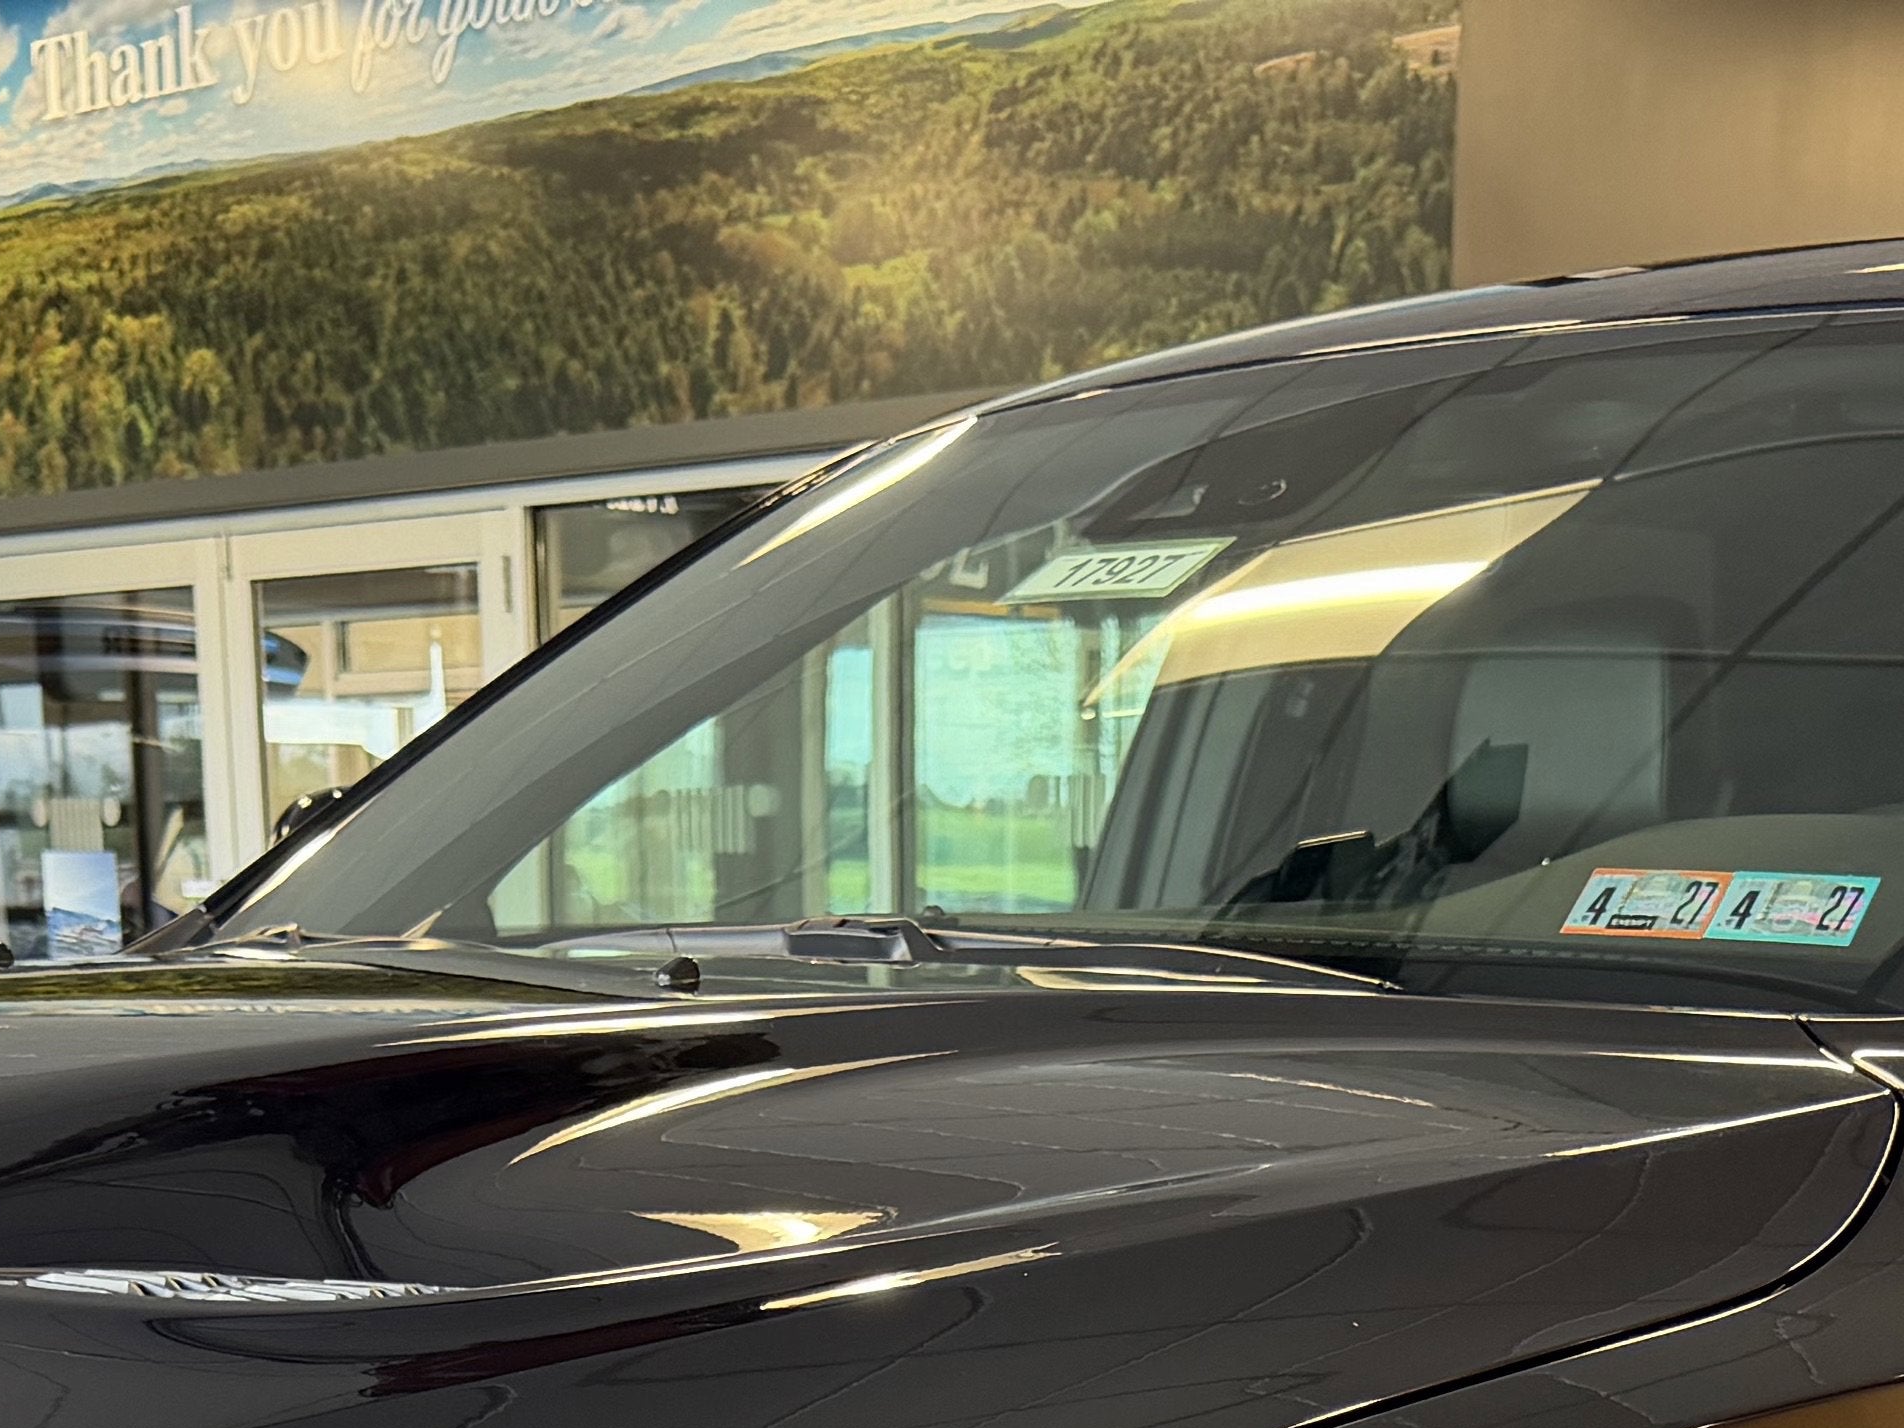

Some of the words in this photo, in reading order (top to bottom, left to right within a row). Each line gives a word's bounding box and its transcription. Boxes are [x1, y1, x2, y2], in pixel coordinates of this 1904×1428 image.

[30, 4, 218, 122] Thank
[230, 0, 344, 104] you
[350, 0, 430, 93] for
[1053, 554, 1185, 588] 17927
[1584, 886, 1616, 925] 4
[1669, 880, 1720, 926] 27
[1729, 890, 1761, 930] 4
[1815, 885, 1865, 931] 27
